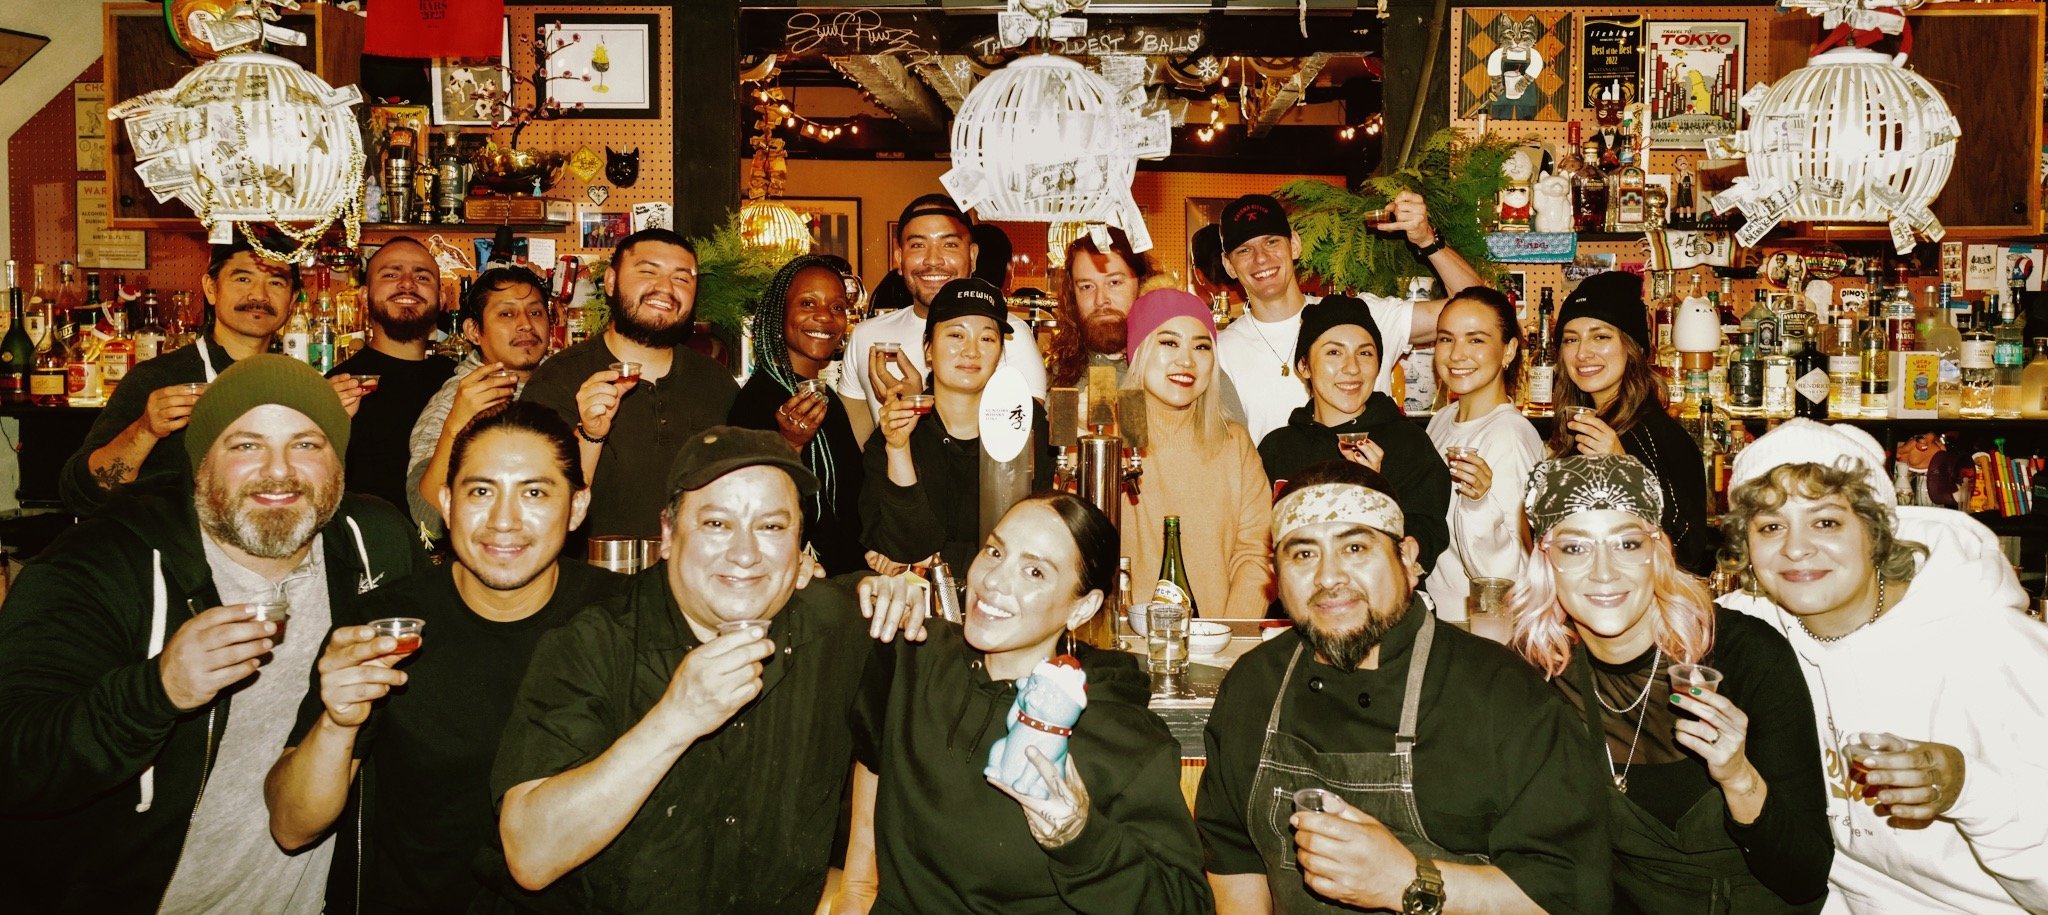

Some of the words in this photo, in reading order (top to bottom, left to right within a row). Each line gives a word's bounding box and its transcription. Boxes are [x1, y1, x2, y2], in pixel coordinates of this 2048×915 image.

[1661, 34, 1732, 45] TOKYO
[1591, 45, 1605, 55] Best
[1619, 44, 1632, 54] Best
[1605, 56, 1618, 65] 2022
[84, 186, 107, 195] WAR
